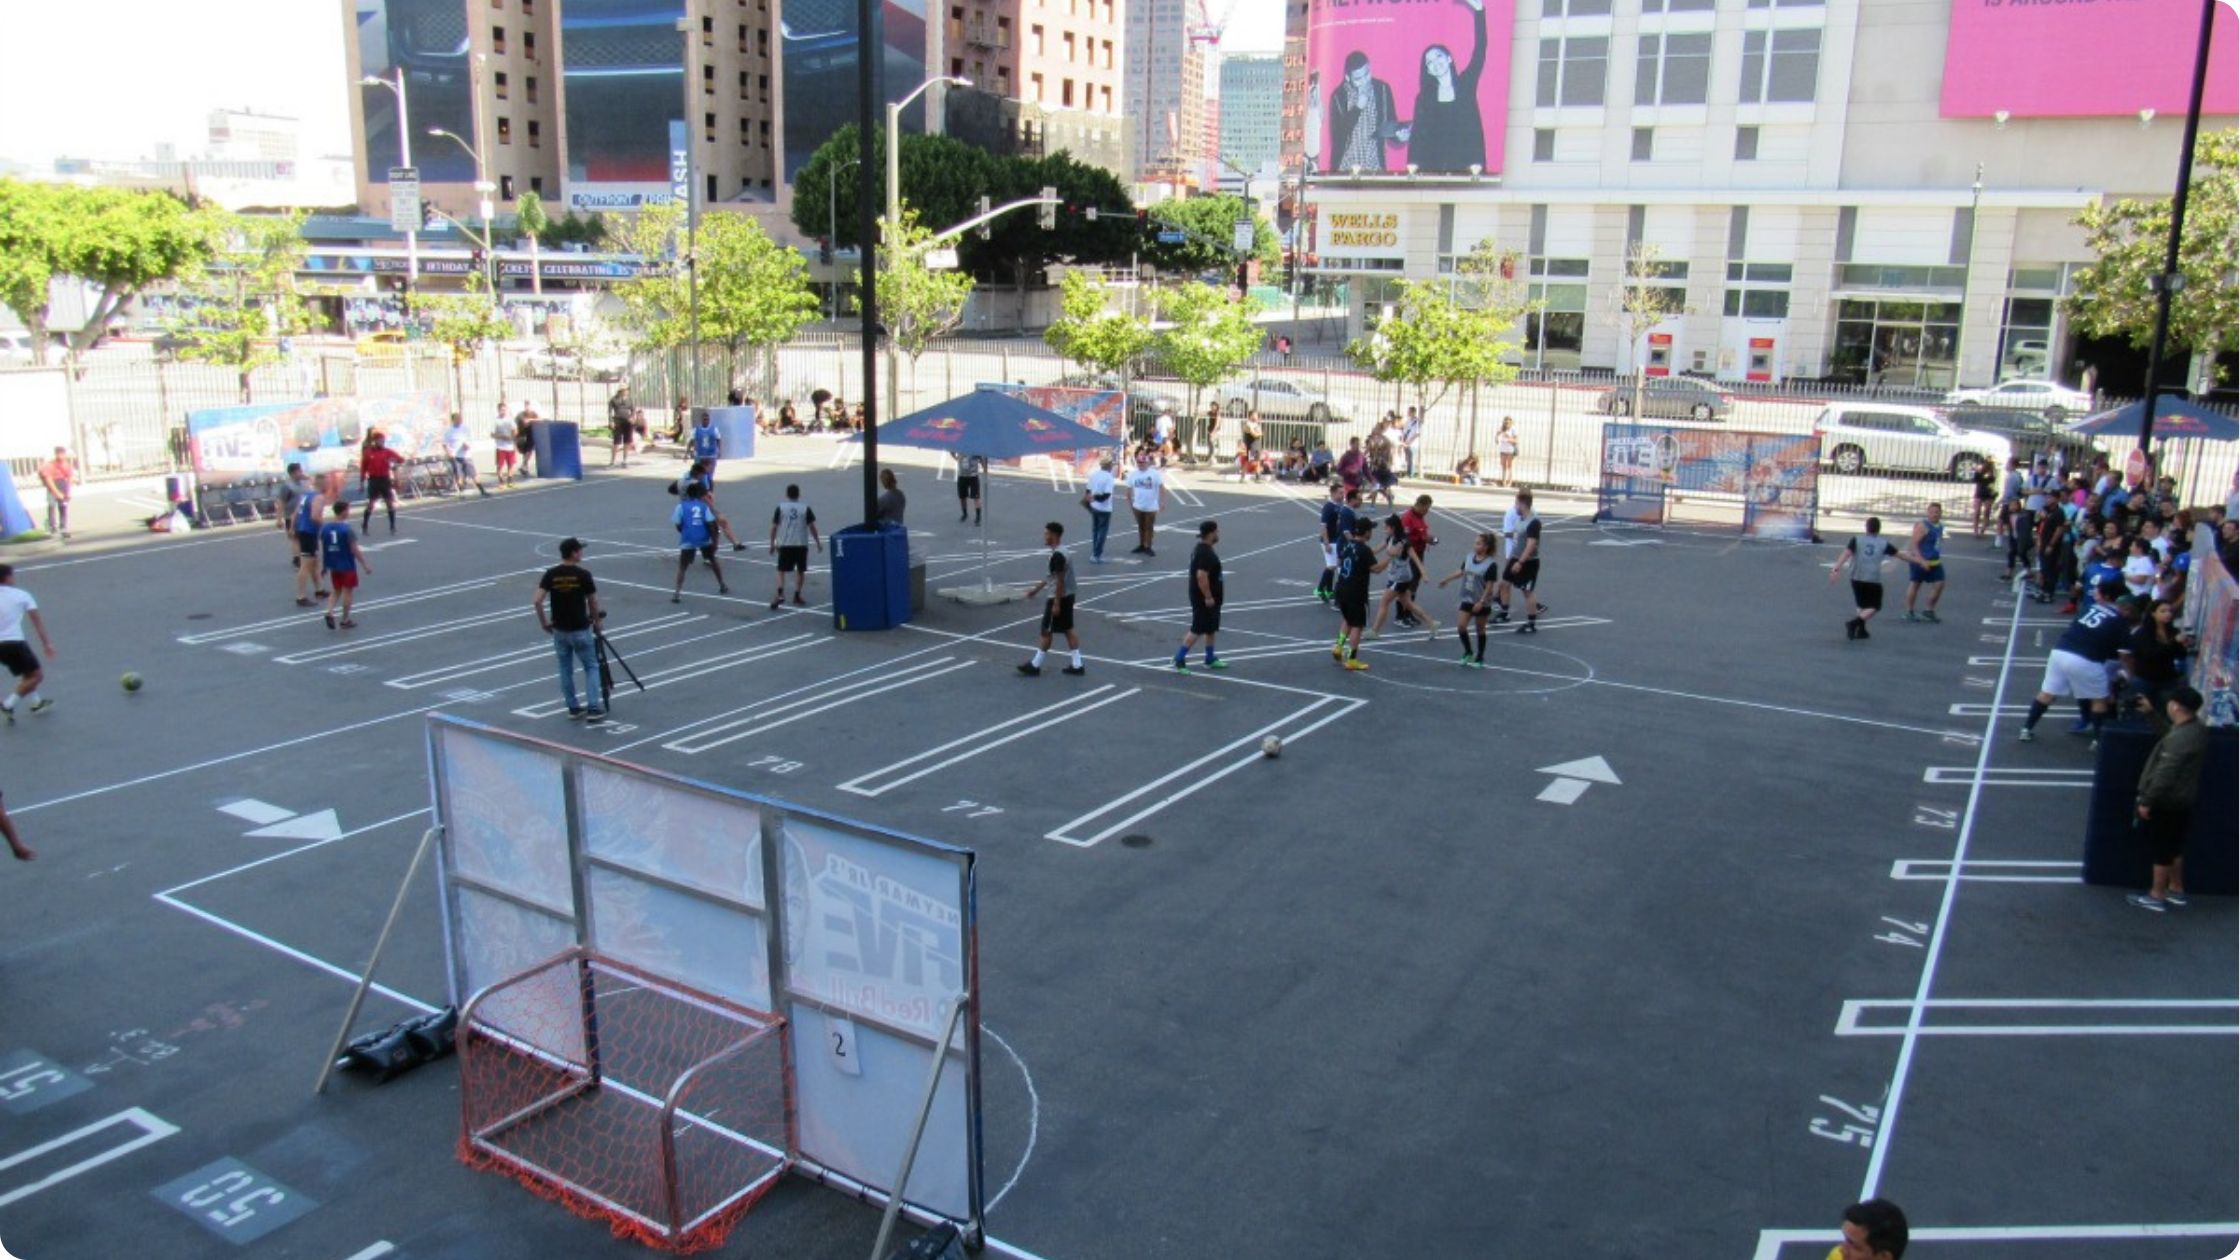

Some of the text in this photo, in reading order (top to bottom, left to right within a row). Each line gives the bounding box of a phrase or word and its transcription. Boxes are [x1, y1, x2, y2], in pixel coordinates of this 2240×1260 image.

[1329, 214, 1398, 229] WELLS
[1331, 231, 1398, 246] FARGO
[691, 506, 701, 518] 2
[789, 508, 798, 519] 3
[330, 530, 338, 544] 1
[2078, 608, 2107, 628] 15
[746, 755, 804, 774] 78
[1873, 916, 1929, 947] 74
[832, 1032, 846, 1057] 2
[1807, 1094, 1880, 1148] 75
[180, 1170, 285, 1227] 50
